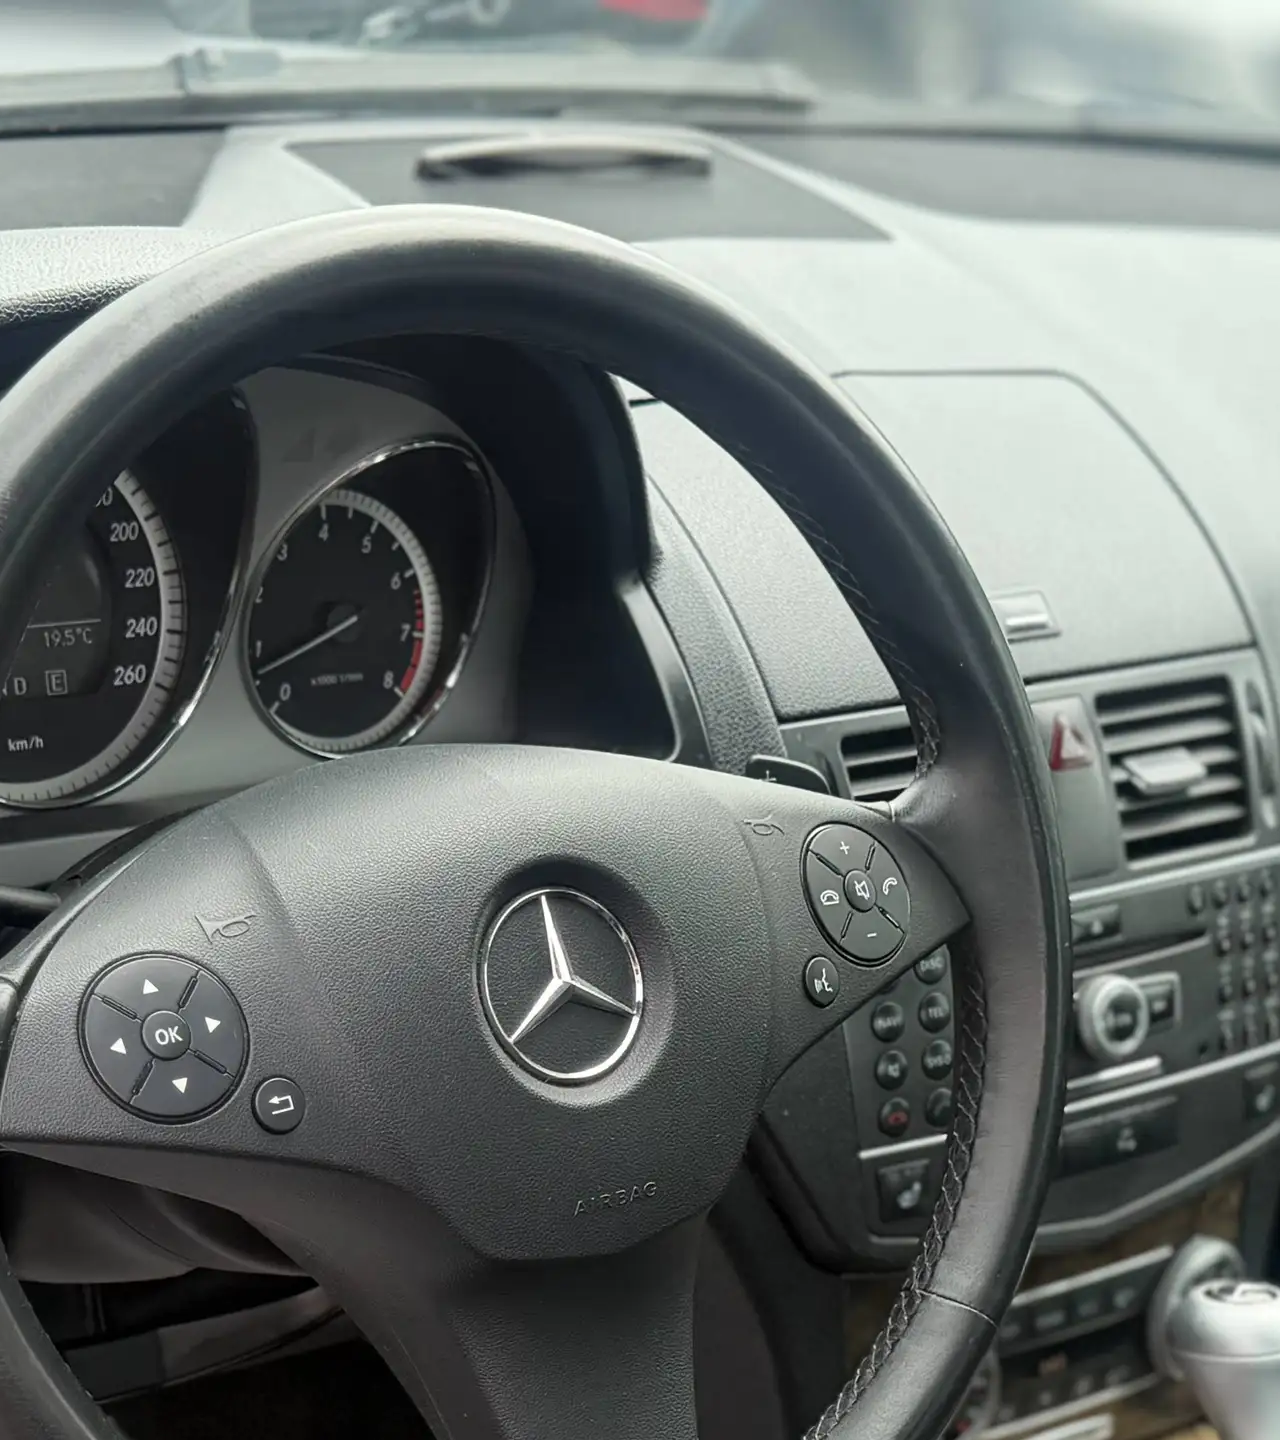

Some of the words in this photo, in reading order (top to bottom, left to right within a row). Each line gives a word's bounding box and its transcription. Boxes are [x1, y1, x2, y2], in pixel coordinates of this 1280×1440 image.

[110, 521, 139, 543] 200
[125, 567, 155, 589] 220
[125, 616, 157, 639] 240
[13, 676, 27, 696] D
[113, 664, 146, 686] 260
[7, 736, 44, 753] km/h
[154, 1025, 183, 1046] OK
